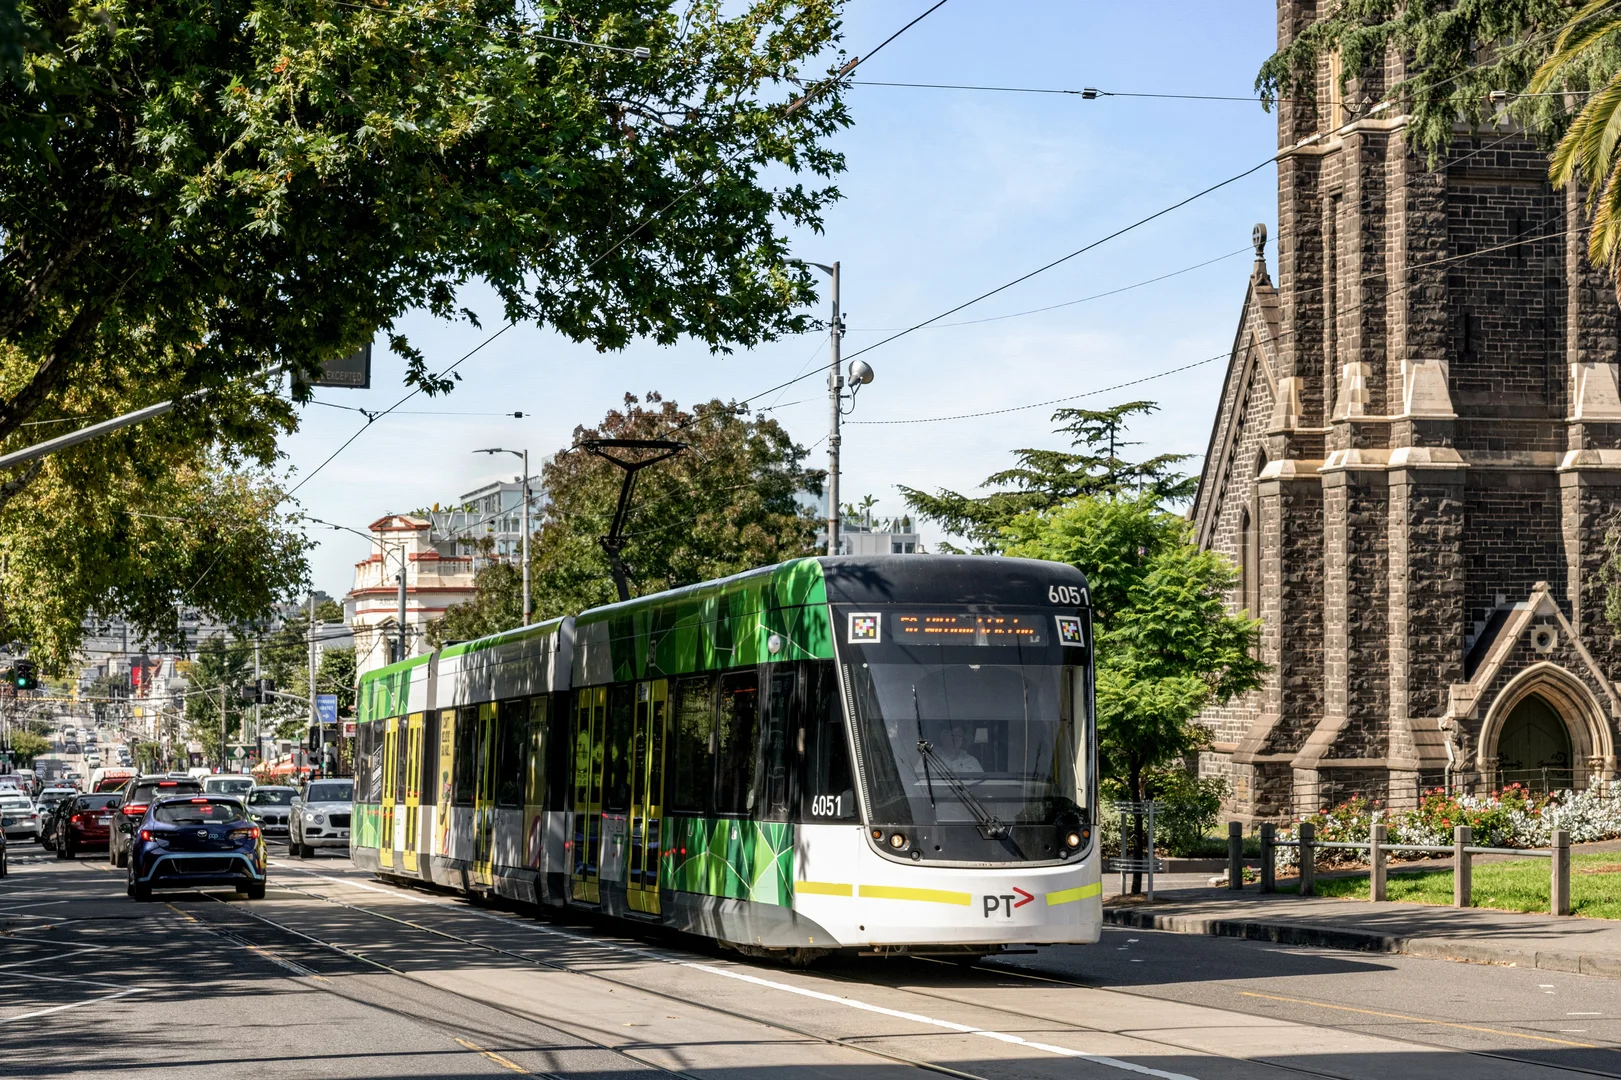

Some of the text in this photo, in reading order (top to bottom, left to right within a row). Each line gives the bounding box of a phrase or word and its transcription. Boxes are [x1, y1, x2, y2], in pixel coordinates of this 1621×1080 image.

[326, 370, 362, 382] EXCEPTED
[1048, 585, 1090, 606] 6051
[811, 794, 842, 816] 6051
